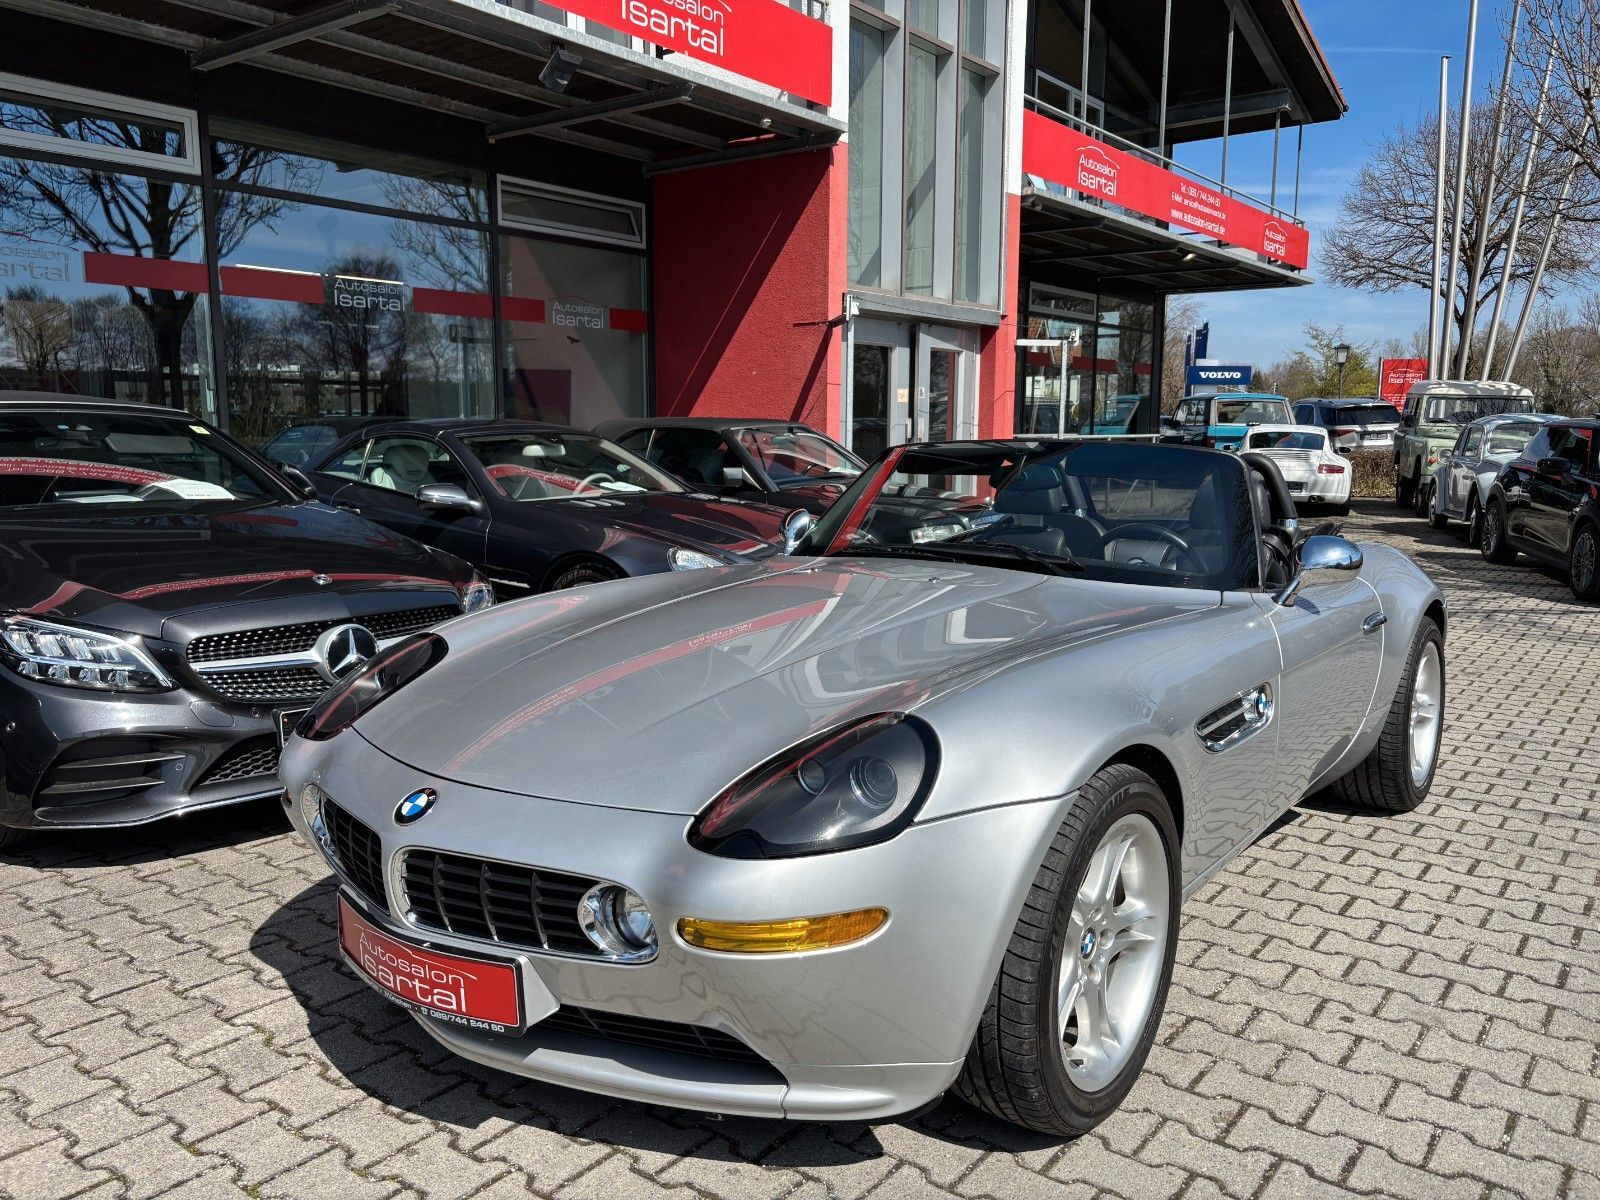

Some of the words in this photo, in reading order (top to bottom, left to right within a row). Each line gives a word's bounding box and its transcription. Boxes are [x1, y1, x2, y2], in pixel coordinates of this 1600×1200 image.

[621, 0, 724, 56] Isartal
[1079, 153, 1117, 178] Autosalon
[1078, 163, 1117, 197] Isartal
[334, 278, 405, 297] Autosalon
[334, 289, 405, 312] Isartal
[552, 301, 604, 315] Autosalon
[552, 310, 604, 329] Isartal
[1199, 371, 1242, 379] VOLVO
[359, 932, 465, 988] Autosalon
[359, 942, 468, 1013] Isartal
[430, 1009, 468, 1025] 089/744
[470, 1019, 489, 1030] 244
[491, 1024, 505, 1033] 60
